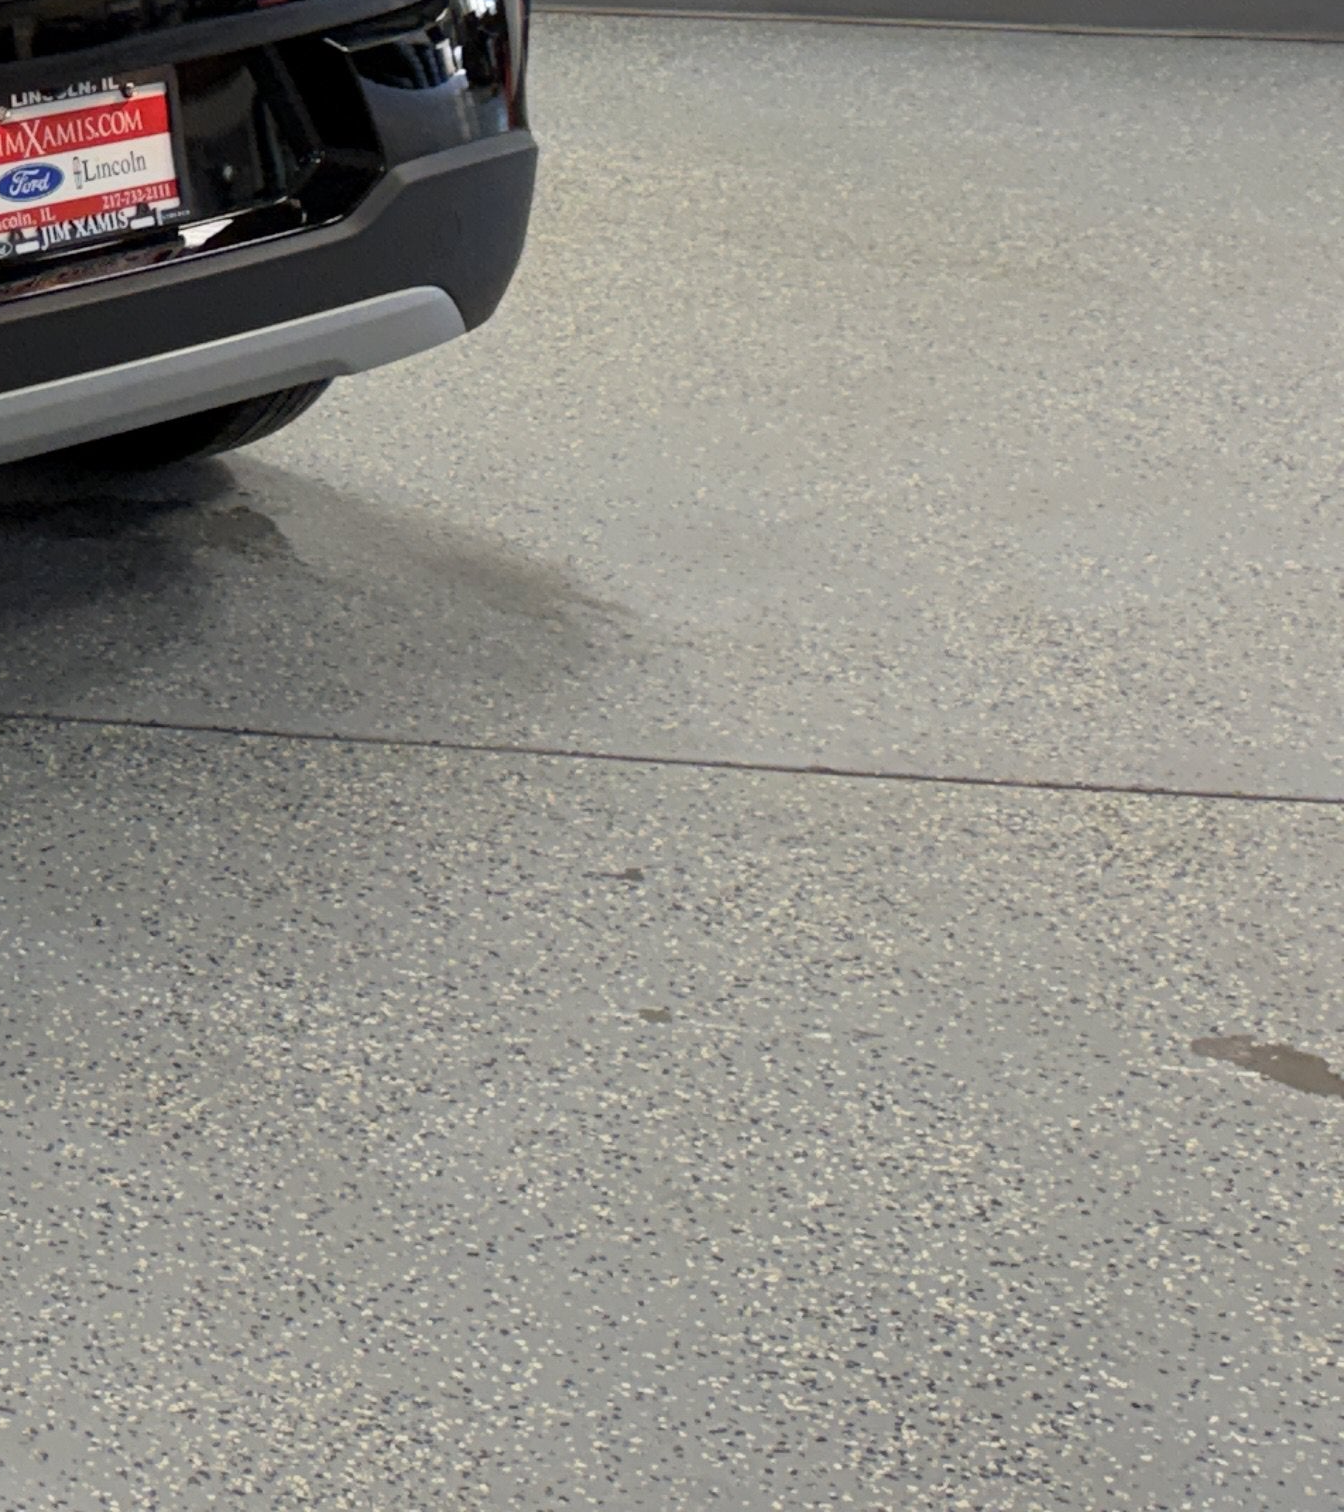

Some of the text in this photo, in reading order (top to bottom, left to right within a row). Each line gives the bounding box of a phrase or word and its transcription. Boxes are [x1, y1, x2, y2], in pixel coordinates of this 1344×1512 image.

[101, 77, 119, 92] IL
[9, 151, 147, 196] Ford Lincoln
[40, 207, 56, 222] IL
[40, 212, 129, 251] JIM XAMIS
